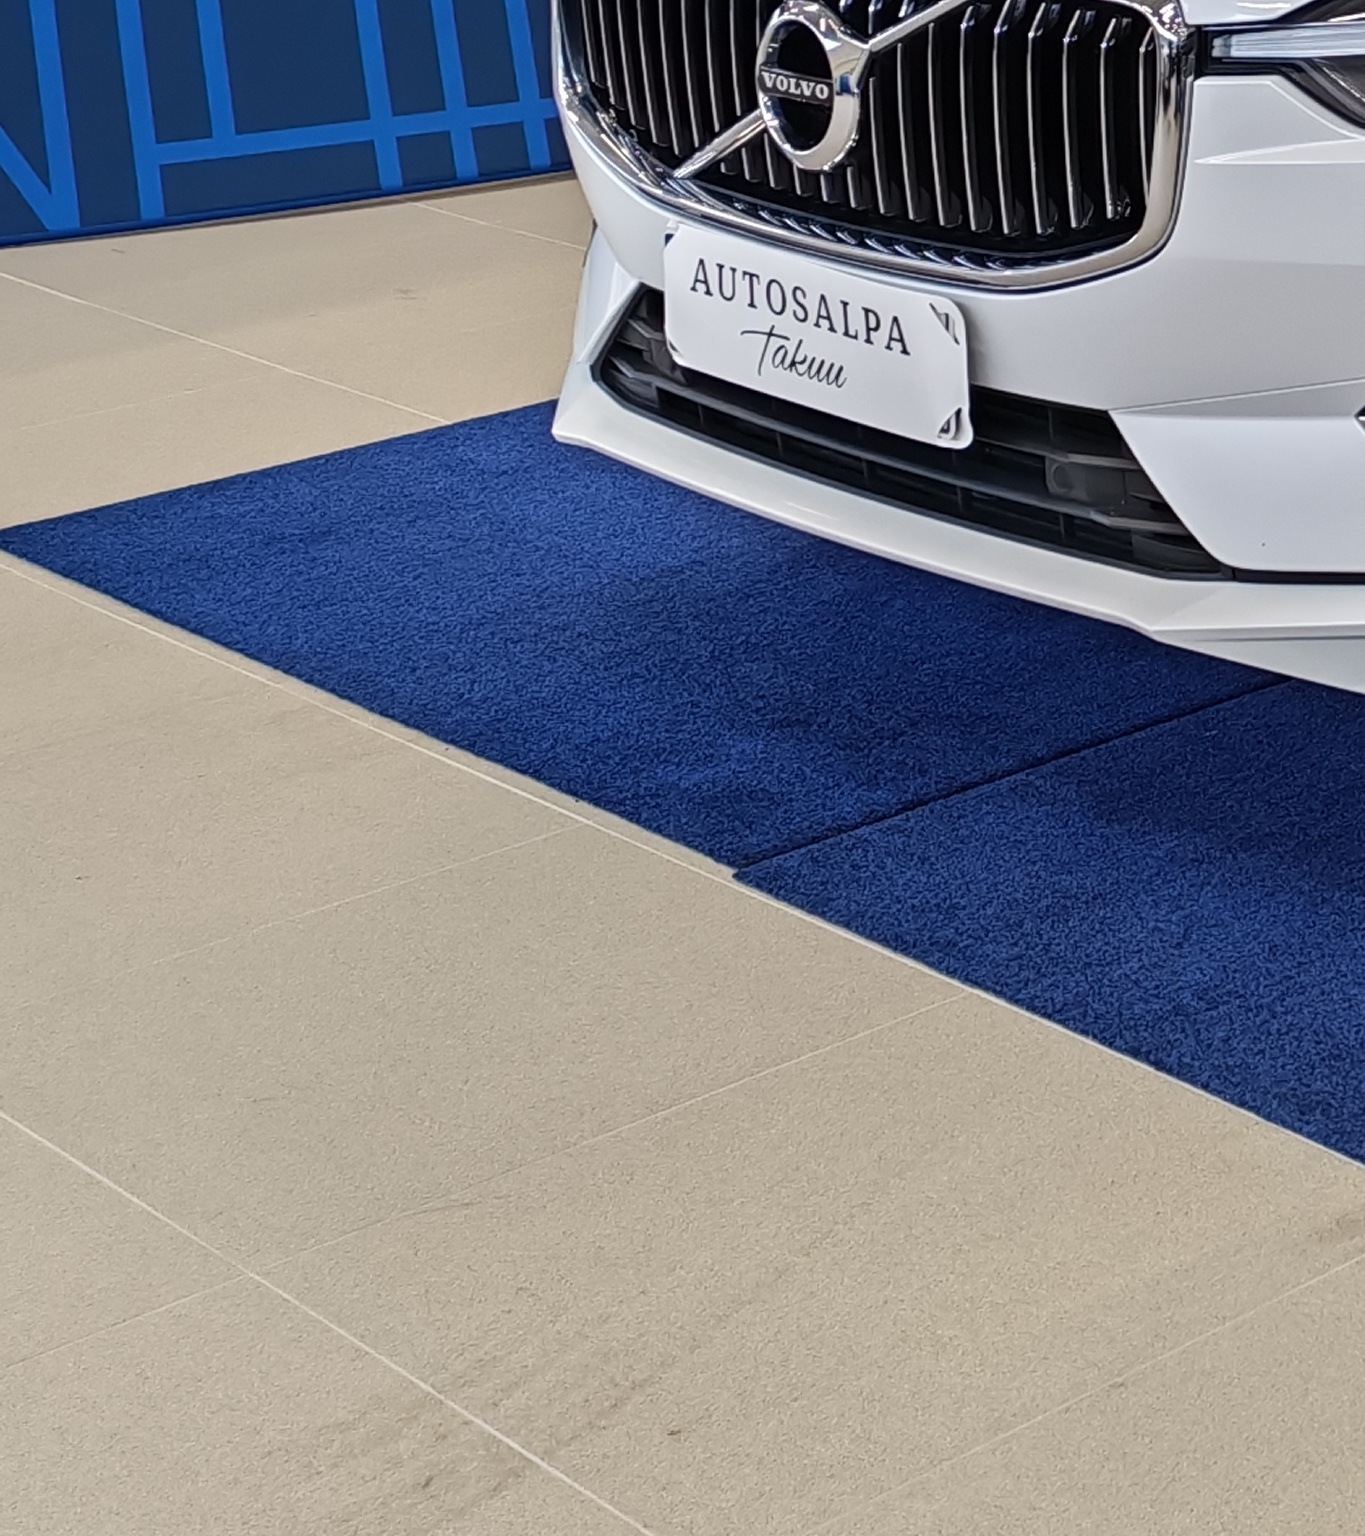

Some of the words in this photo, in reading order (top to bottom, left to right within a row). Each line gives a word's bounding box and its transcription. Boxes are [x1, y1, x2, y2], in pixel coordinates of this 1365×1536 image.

[761, 70, 829, 100] VOLVO
[690, 257, 911, 356] AUTOSALPA
[739, 324, 848, 389] Takuu
